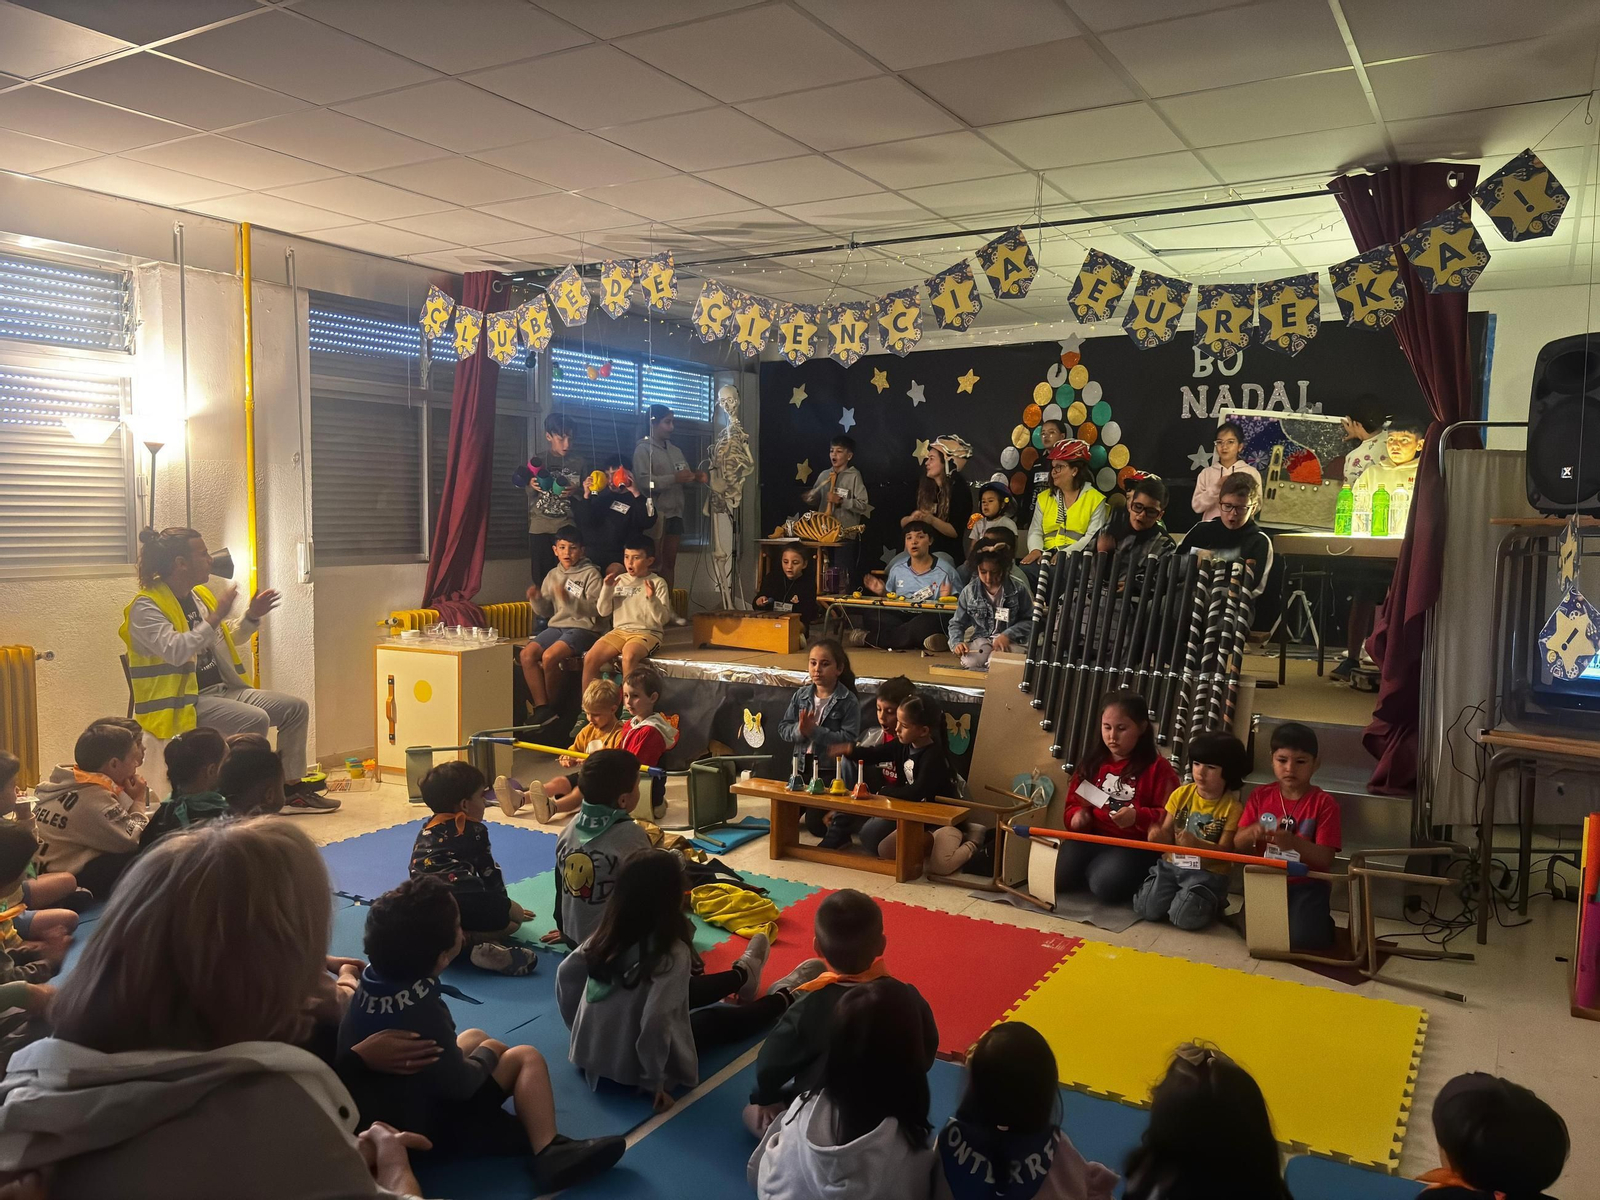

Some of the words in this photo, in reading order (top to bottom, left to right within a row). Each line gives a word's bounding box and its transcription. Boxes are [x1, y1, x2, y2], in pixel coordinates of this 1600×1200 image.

[430, 291, 579, 347] CLUBE
[610, 274, 665, 298] DE
[708, 257, 1023, 345] CIENCIA
[1088, 189, 1535, 334] EUREKA!
[1192, 346, 1243, 378] BO
[1180, 380, 1323, 419] NADAL
